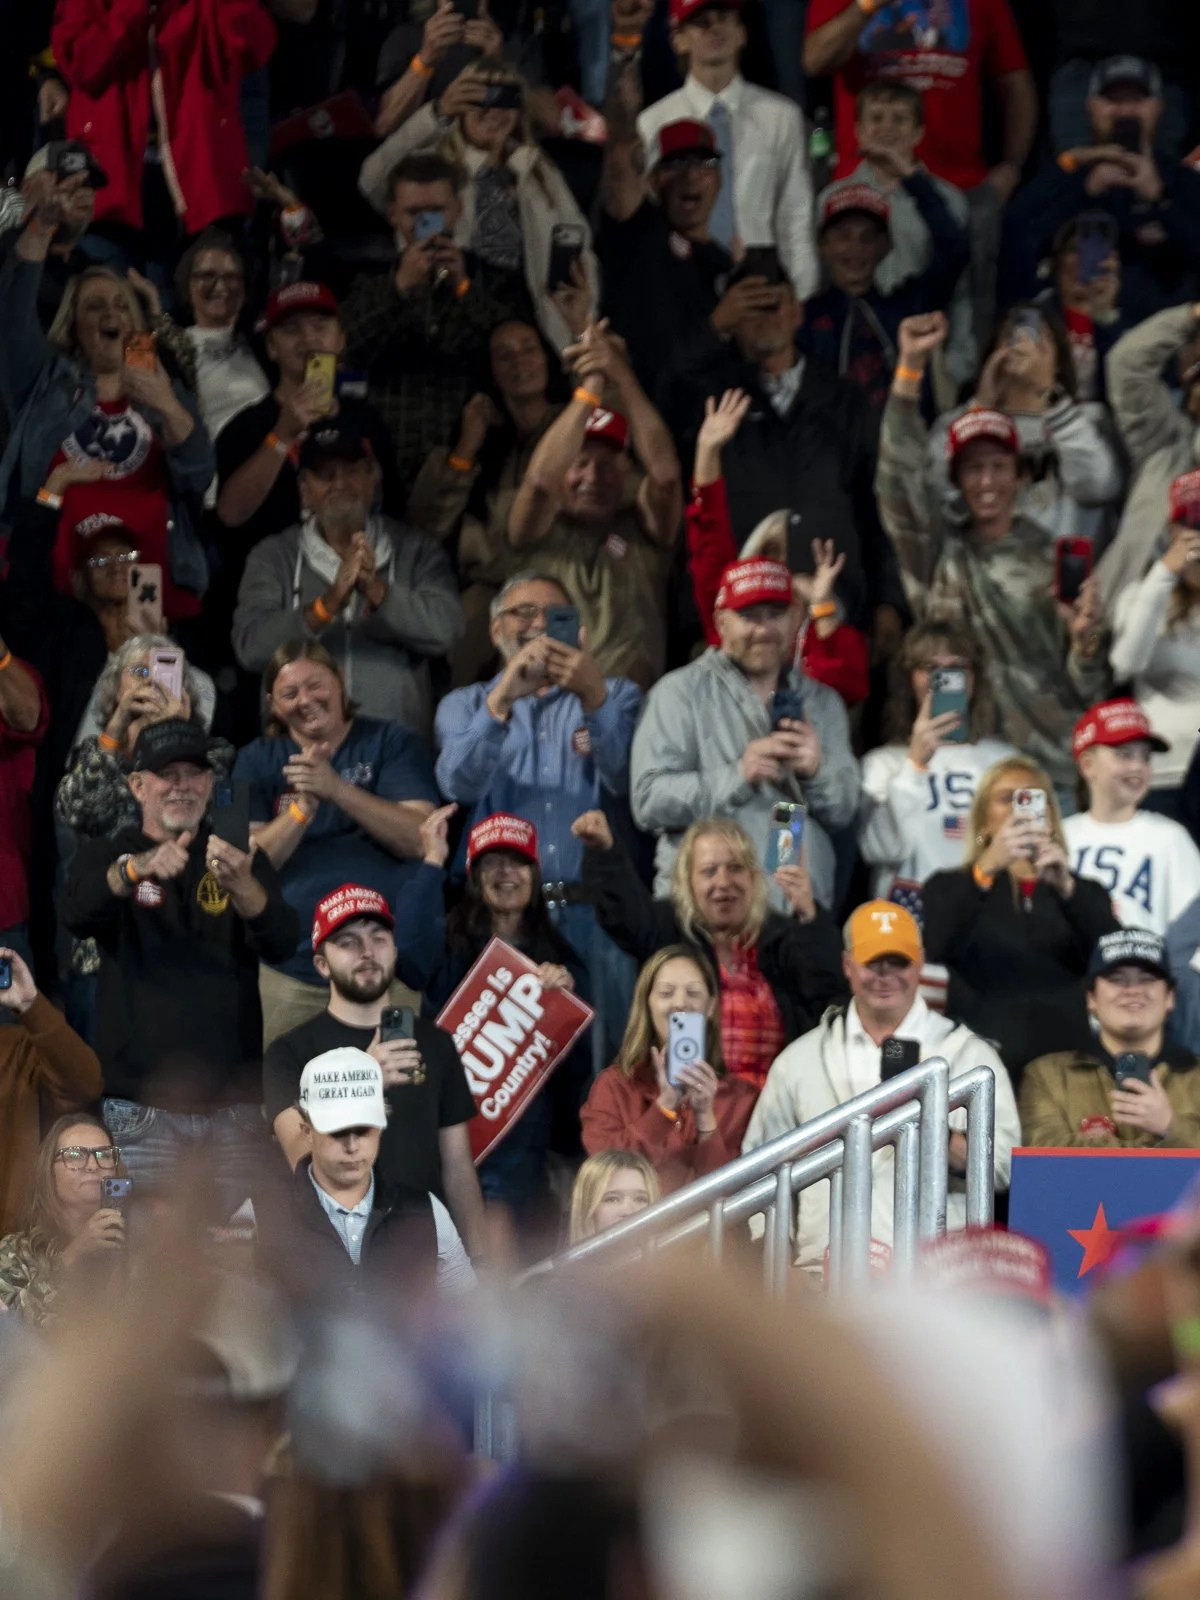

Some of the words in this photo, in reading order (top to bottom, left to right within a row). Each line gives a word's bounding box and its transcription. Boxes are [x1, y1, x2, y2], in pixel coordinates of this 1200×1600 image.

[320, 891, 344, 912] MAKE
[345, 888, 384, 904] AMERICA
[327, 899, 355, 922] GREAT
[356, 899, 382, 912] AGAIN
[871, 911, 898, 934] T
[486, 966, 513, 993] Is
[313, 1071, 340, 1084] MAKE
[341, 1069, 378, 1081] AMERICA
[480, 1030, 551, 1120] Country!
[318, 1087, 349, 1099] GREAT
[350, 1086, 375, 1098] AGAIN
